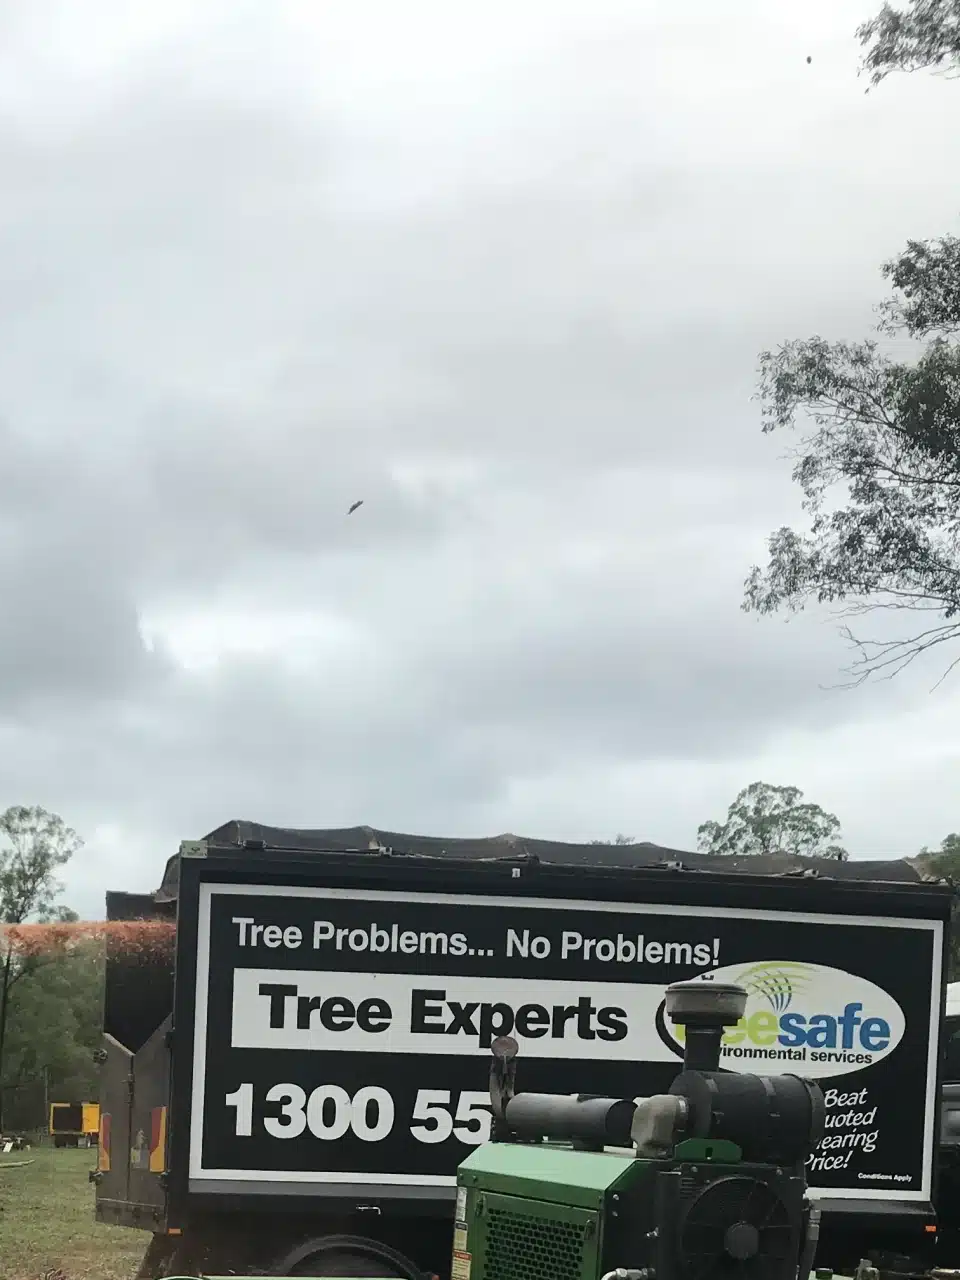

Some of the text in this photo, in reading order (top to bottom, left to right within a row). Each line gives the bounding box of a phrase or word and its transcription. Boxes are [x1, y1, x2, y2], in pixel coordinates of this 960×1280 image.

[232, 917, 720, 966] Tree Problems... No Problems!
[258, 983, 629, 1050] Tree Experts
[810, 1049, 873, 1064] services
[824, 1087, 868, 1108] Beat
[225, 1083, 494, 1145] 1300 55
[824, 1106, 878, 1128] uoted
[816, 1128, 879, 1152] earing
[858, 1172, 912, 1182] Conditions Apply
